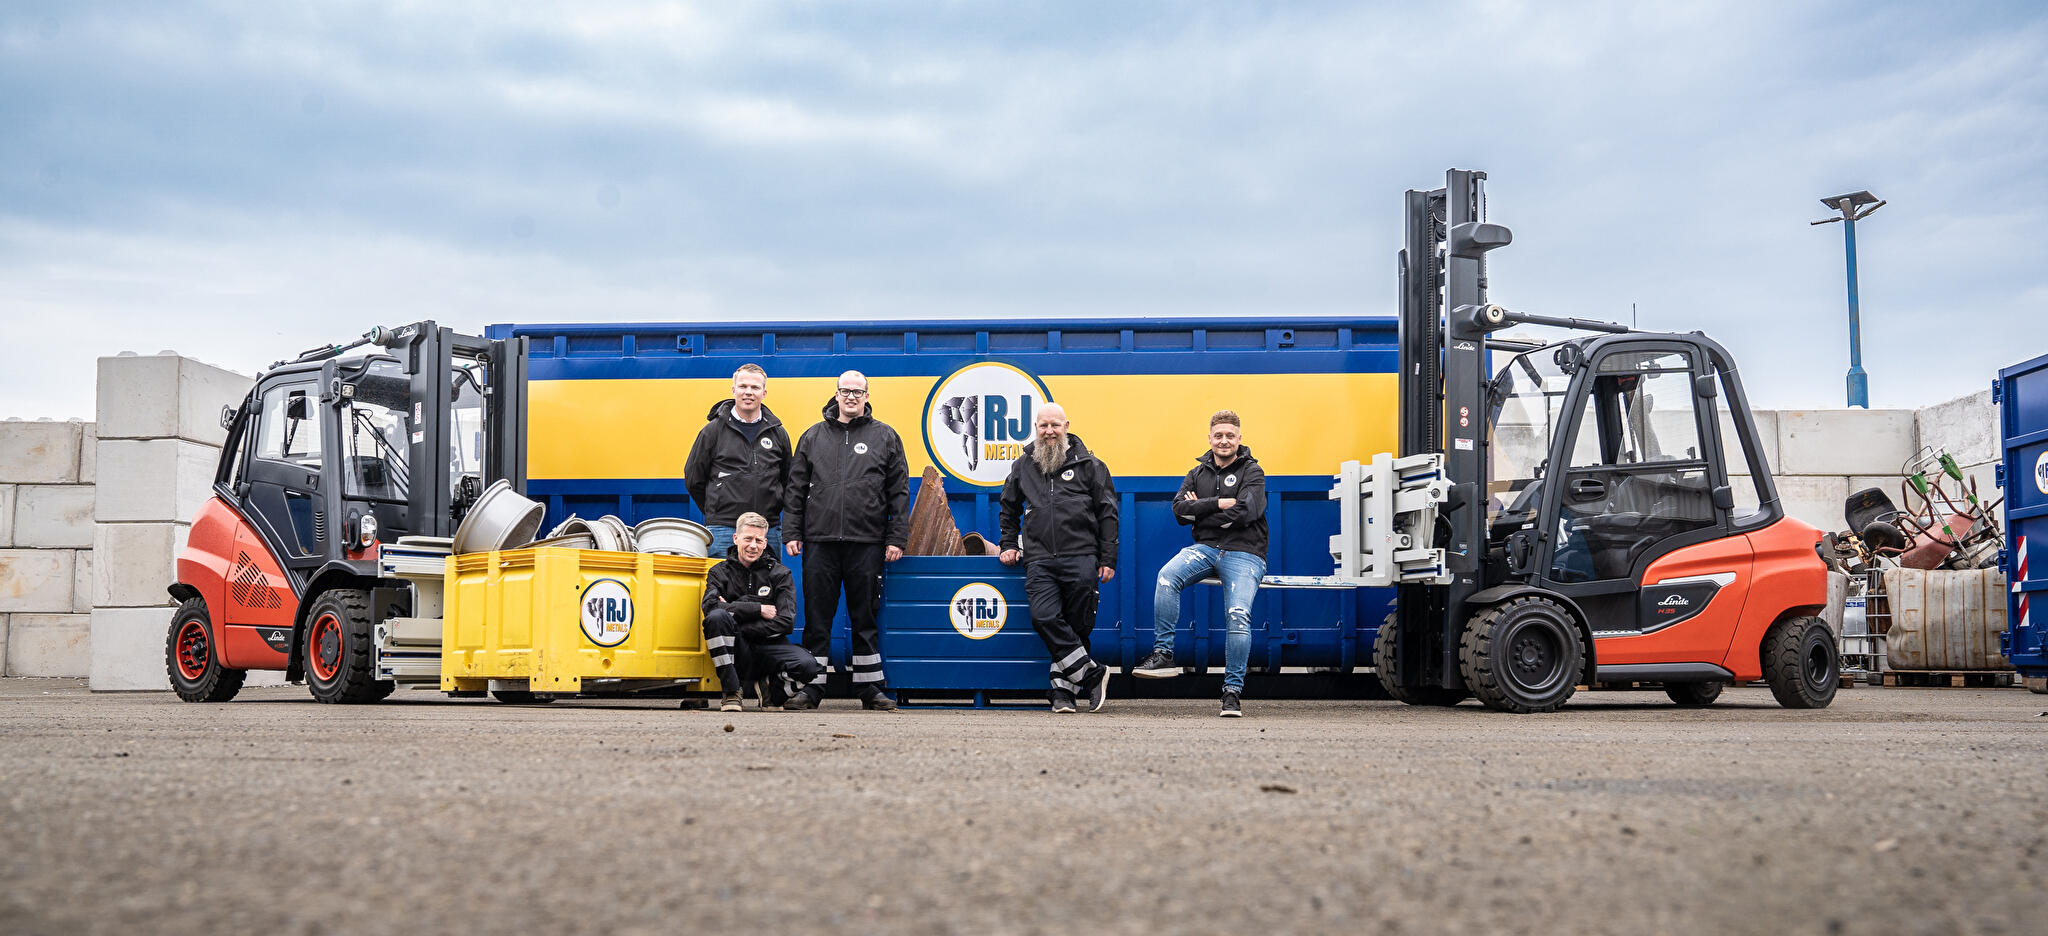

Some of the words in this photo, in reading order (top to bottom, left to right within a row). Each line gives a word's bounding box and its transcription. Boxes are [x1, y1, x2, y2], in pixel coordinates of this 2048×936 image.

[1453, 341, 1475, 351] Linde
[984, 395, 1032, 441] RJ
[1657, 594, 1689, 606] Linde
[606, 597, 627, 622] RJ
[976, 597, 998, 619] RJ
[606, 623, 628, 633] METALS
[976, 620, 999, 628] METALS
[267, 630, 285, 641] Linde
